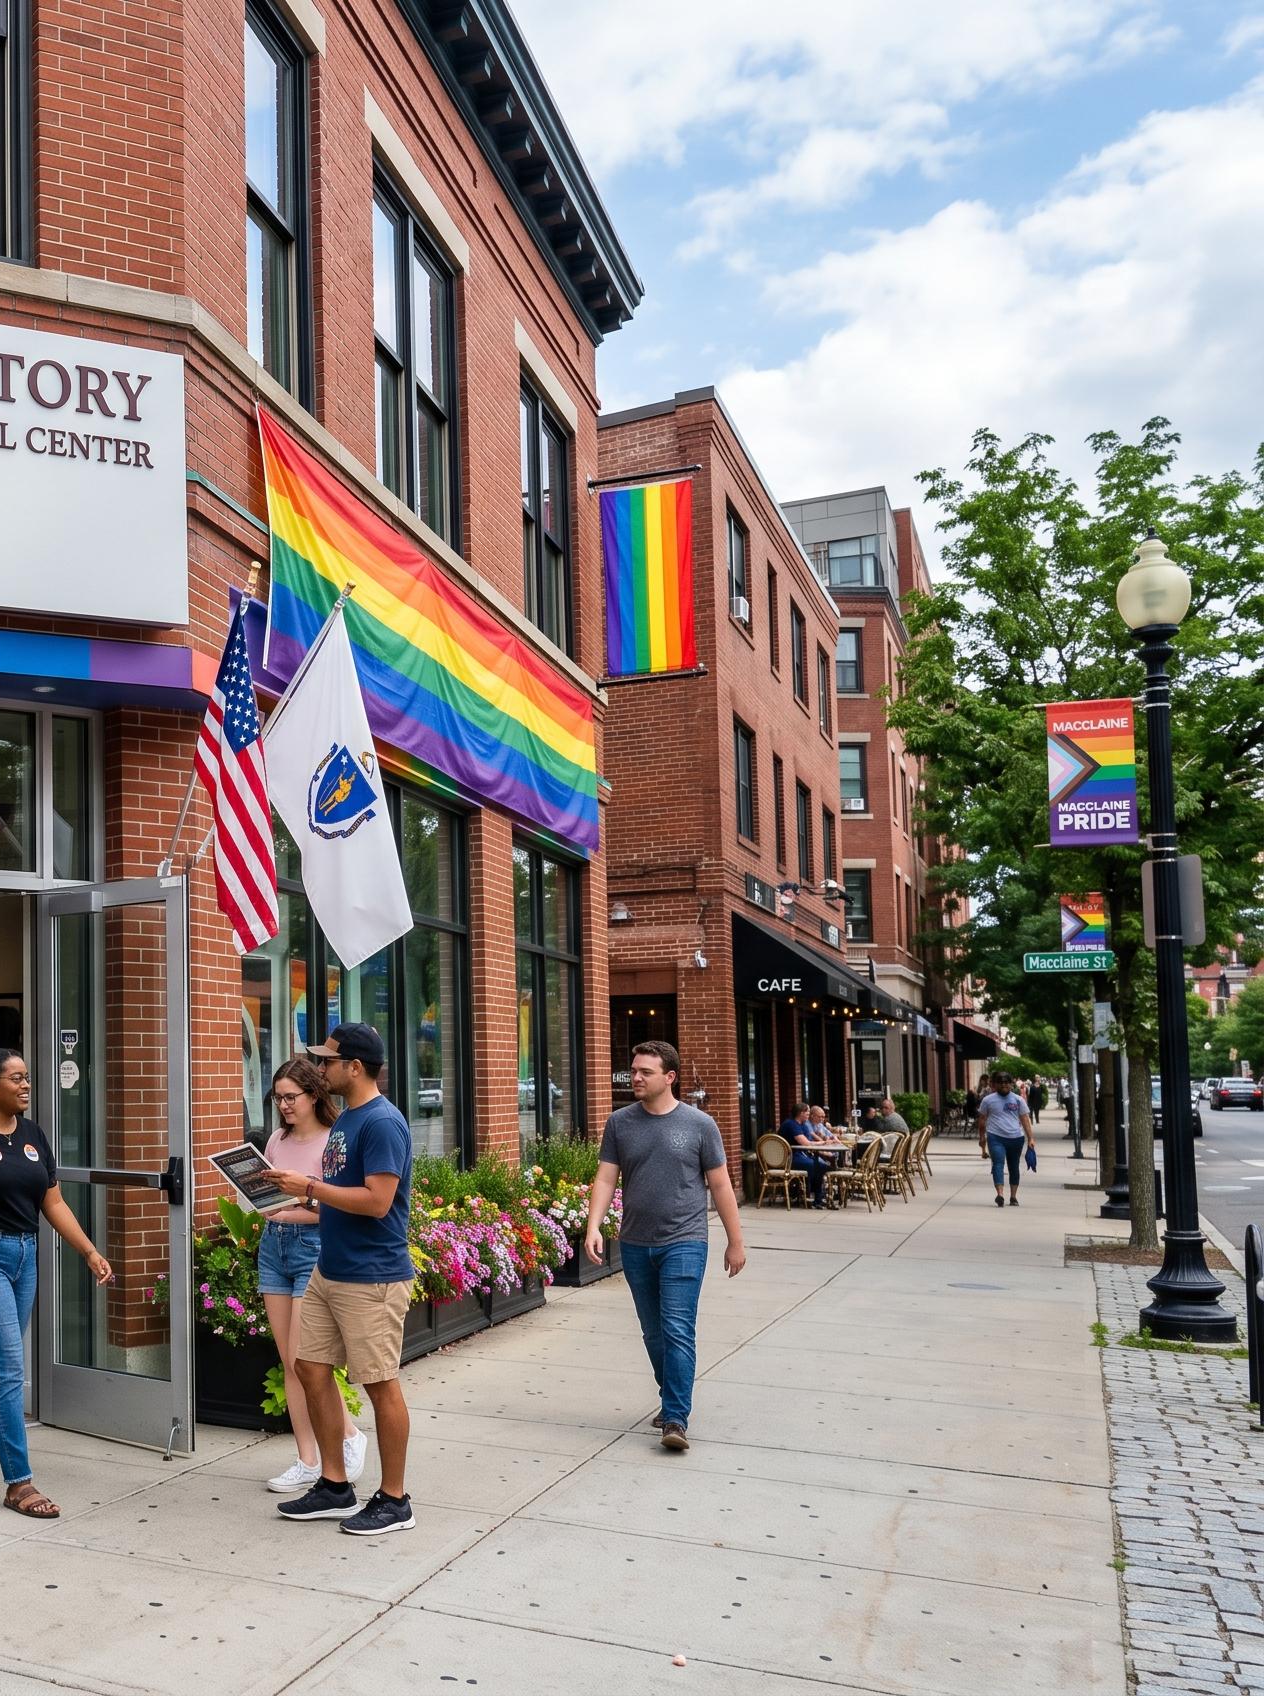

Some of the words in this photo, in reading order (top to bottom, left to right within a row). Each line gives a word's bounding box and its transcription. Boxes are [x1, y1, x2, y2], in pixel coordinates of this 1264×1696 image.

[25, 426, 155, 470] CENTER
[1052, 717, 1129, 733] MACCLAINE
[1057, 799, 1131, 812] MACCLAINE
[1058, 811, 1131, 831] PRIDE
[1029, 955, 1089, 970] Macclaine
[1092, 954, 1108, 970] St
[757, 978, 802, 992] CAFE
